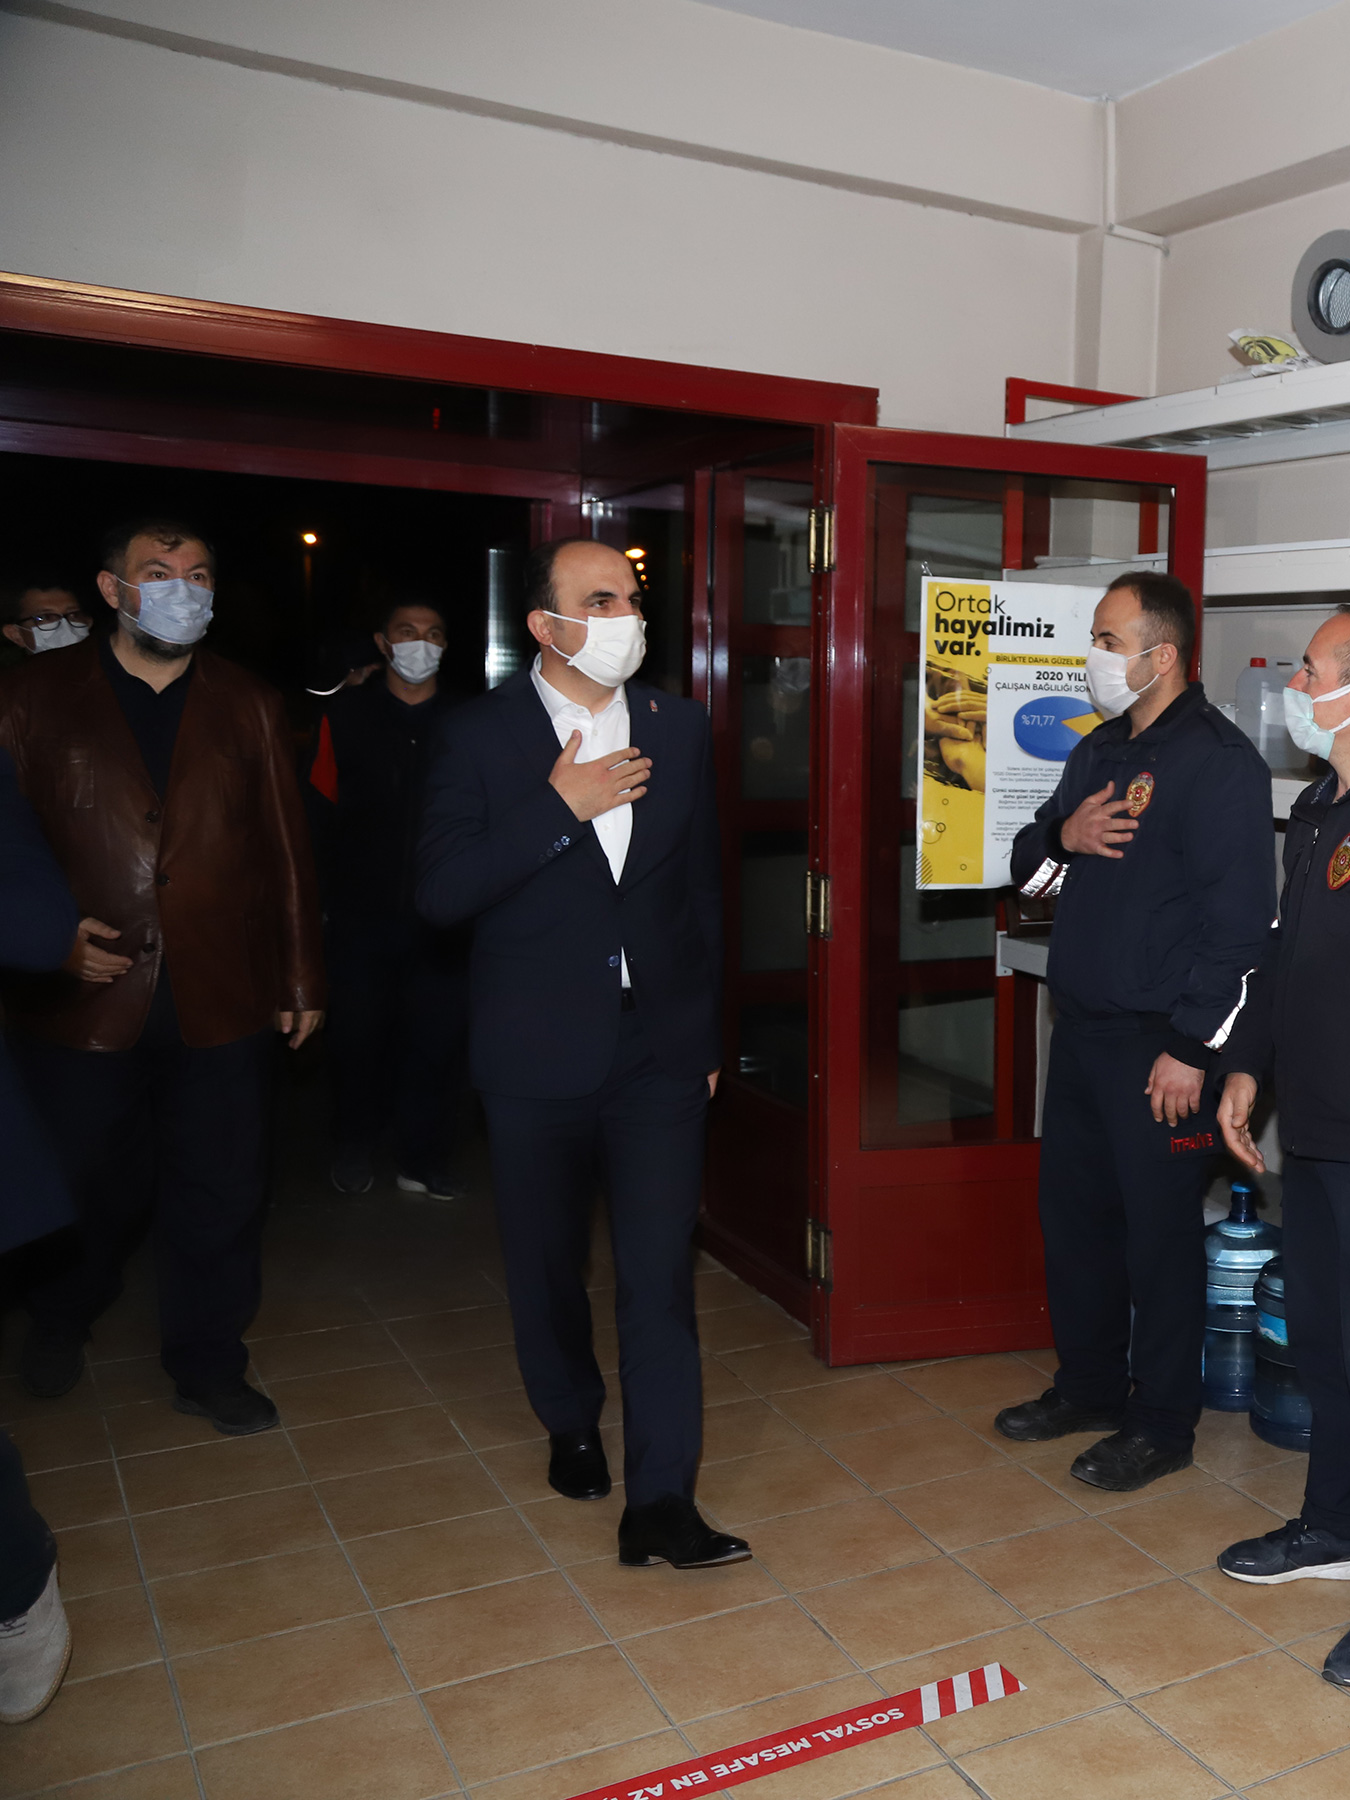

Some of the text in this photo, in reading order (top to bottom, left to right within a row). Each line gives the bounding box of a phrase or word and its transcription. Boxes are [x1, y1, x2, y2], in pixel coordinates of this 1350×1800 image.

[936, 590, 1006, 615] Ortak
[935, 613, 1055, 639] hayalimiz
[934, 640, 981, 656] var.
[996, 655, 1026, 664] BİRLİKTE
[1051, 657, 1074, 665] GÜZEL
[1035, 671, 1087, 682] 2020 YILI
[995, 682, 1030, 692] ÇALIŞAN
[1033, 682, 1072, 692] BAĞLILIĞI
[1022, 713, 1055, 728] %71,77
[812, 1708, 904, 1743] SOSYAL
[711, 1736, 812, 1778] MESAFE
[671, 1770, 709, 1791] EN
